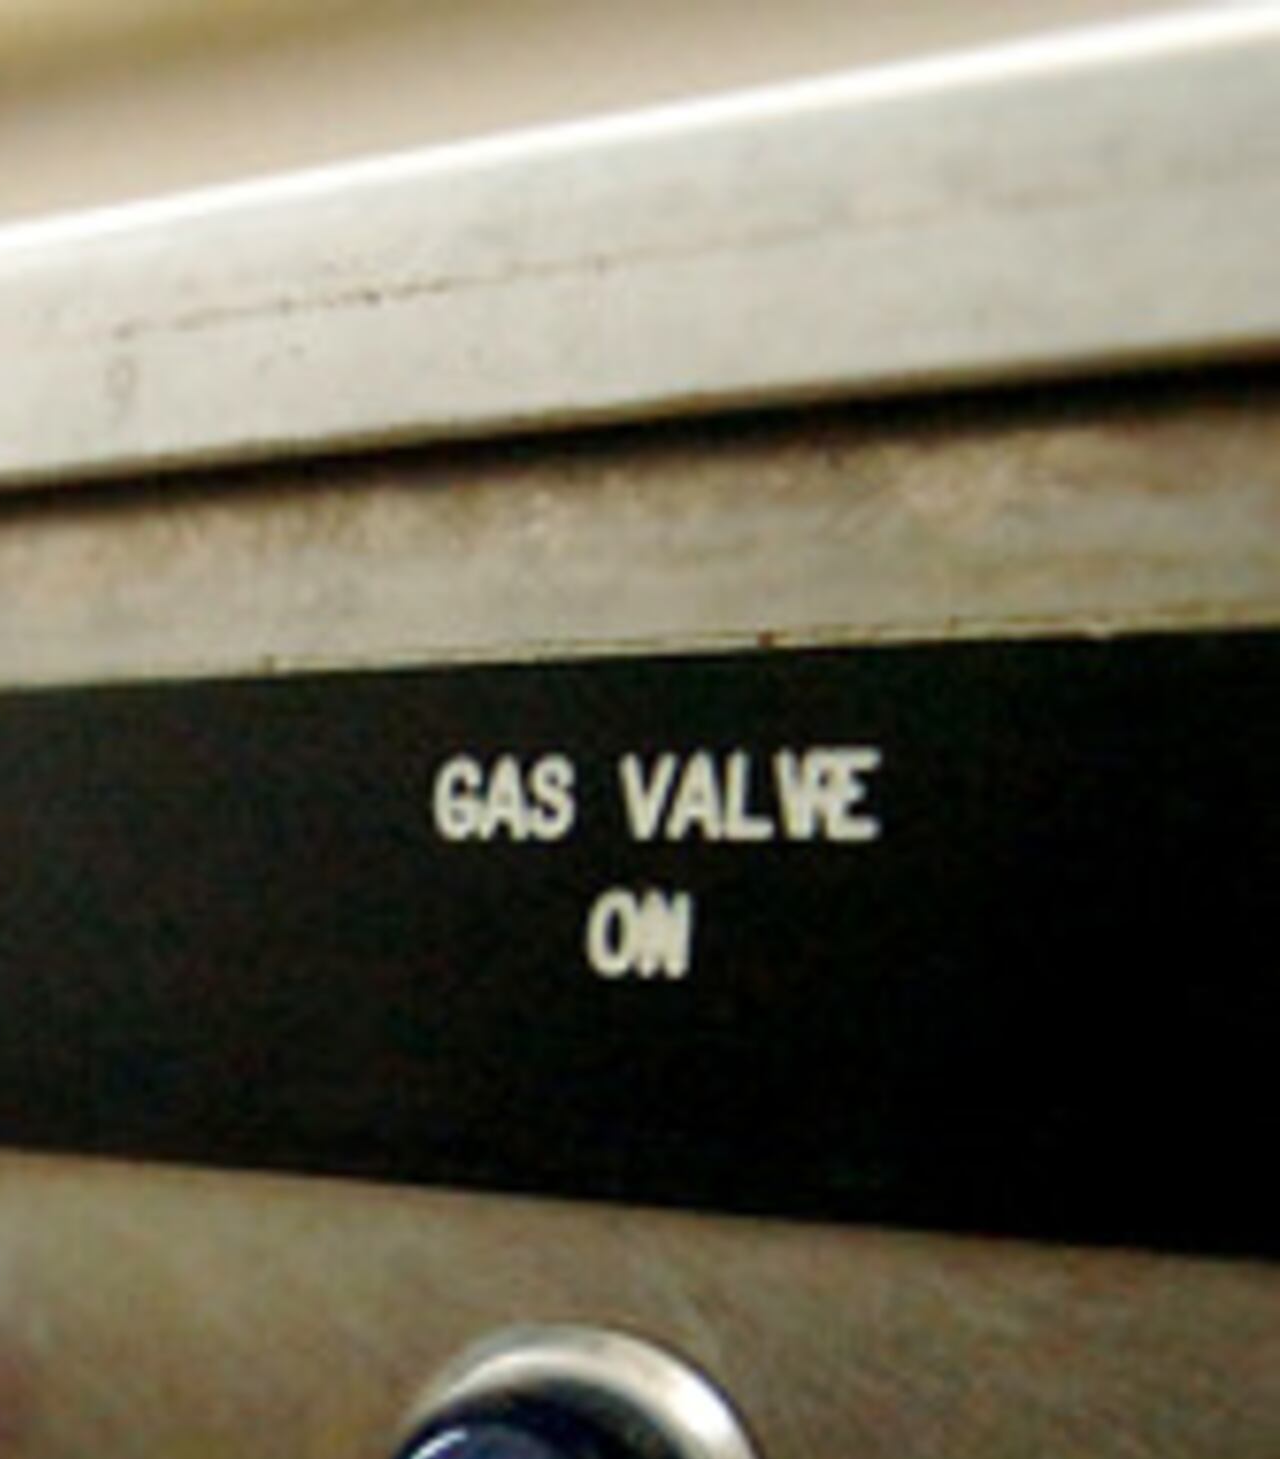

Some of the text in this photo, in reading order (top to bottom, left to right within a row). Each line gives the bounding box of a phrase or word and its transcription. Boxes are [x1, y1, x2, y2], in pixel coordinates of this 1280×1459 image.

[433, 745, 882, 841] GAS VALVE
[585, 886, 693, 980] ON
